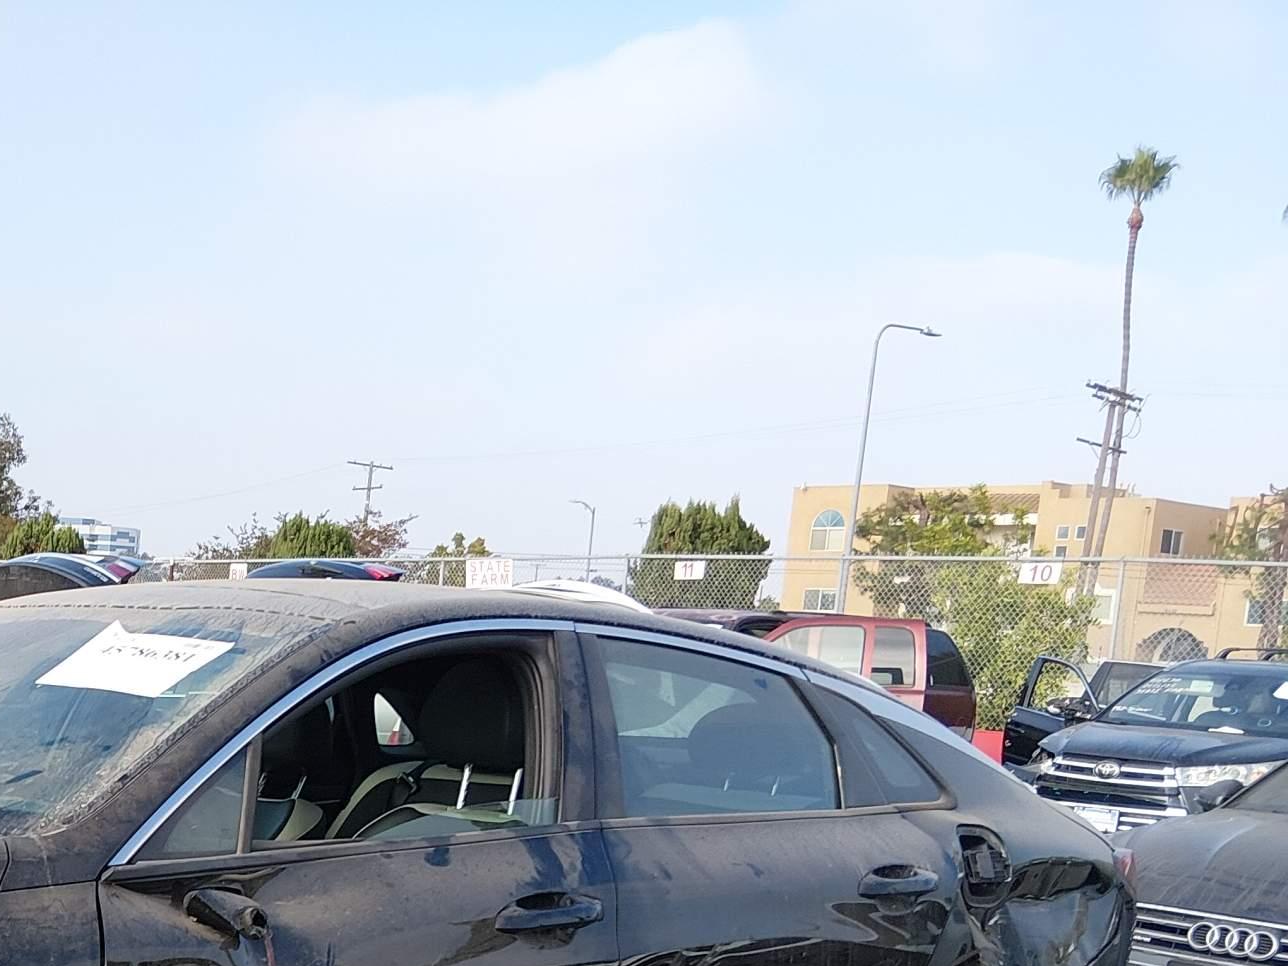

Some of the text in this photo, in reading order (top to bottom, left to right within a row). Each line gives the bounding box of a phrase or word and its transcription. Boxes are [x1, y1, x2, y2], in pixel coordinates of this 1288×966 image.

[469, 560, 511, 573] STATE
[681, 562, 694, 578] 11
[1030, 564, 1053, 582] 10
[471, 573, 510, 586] FARM
